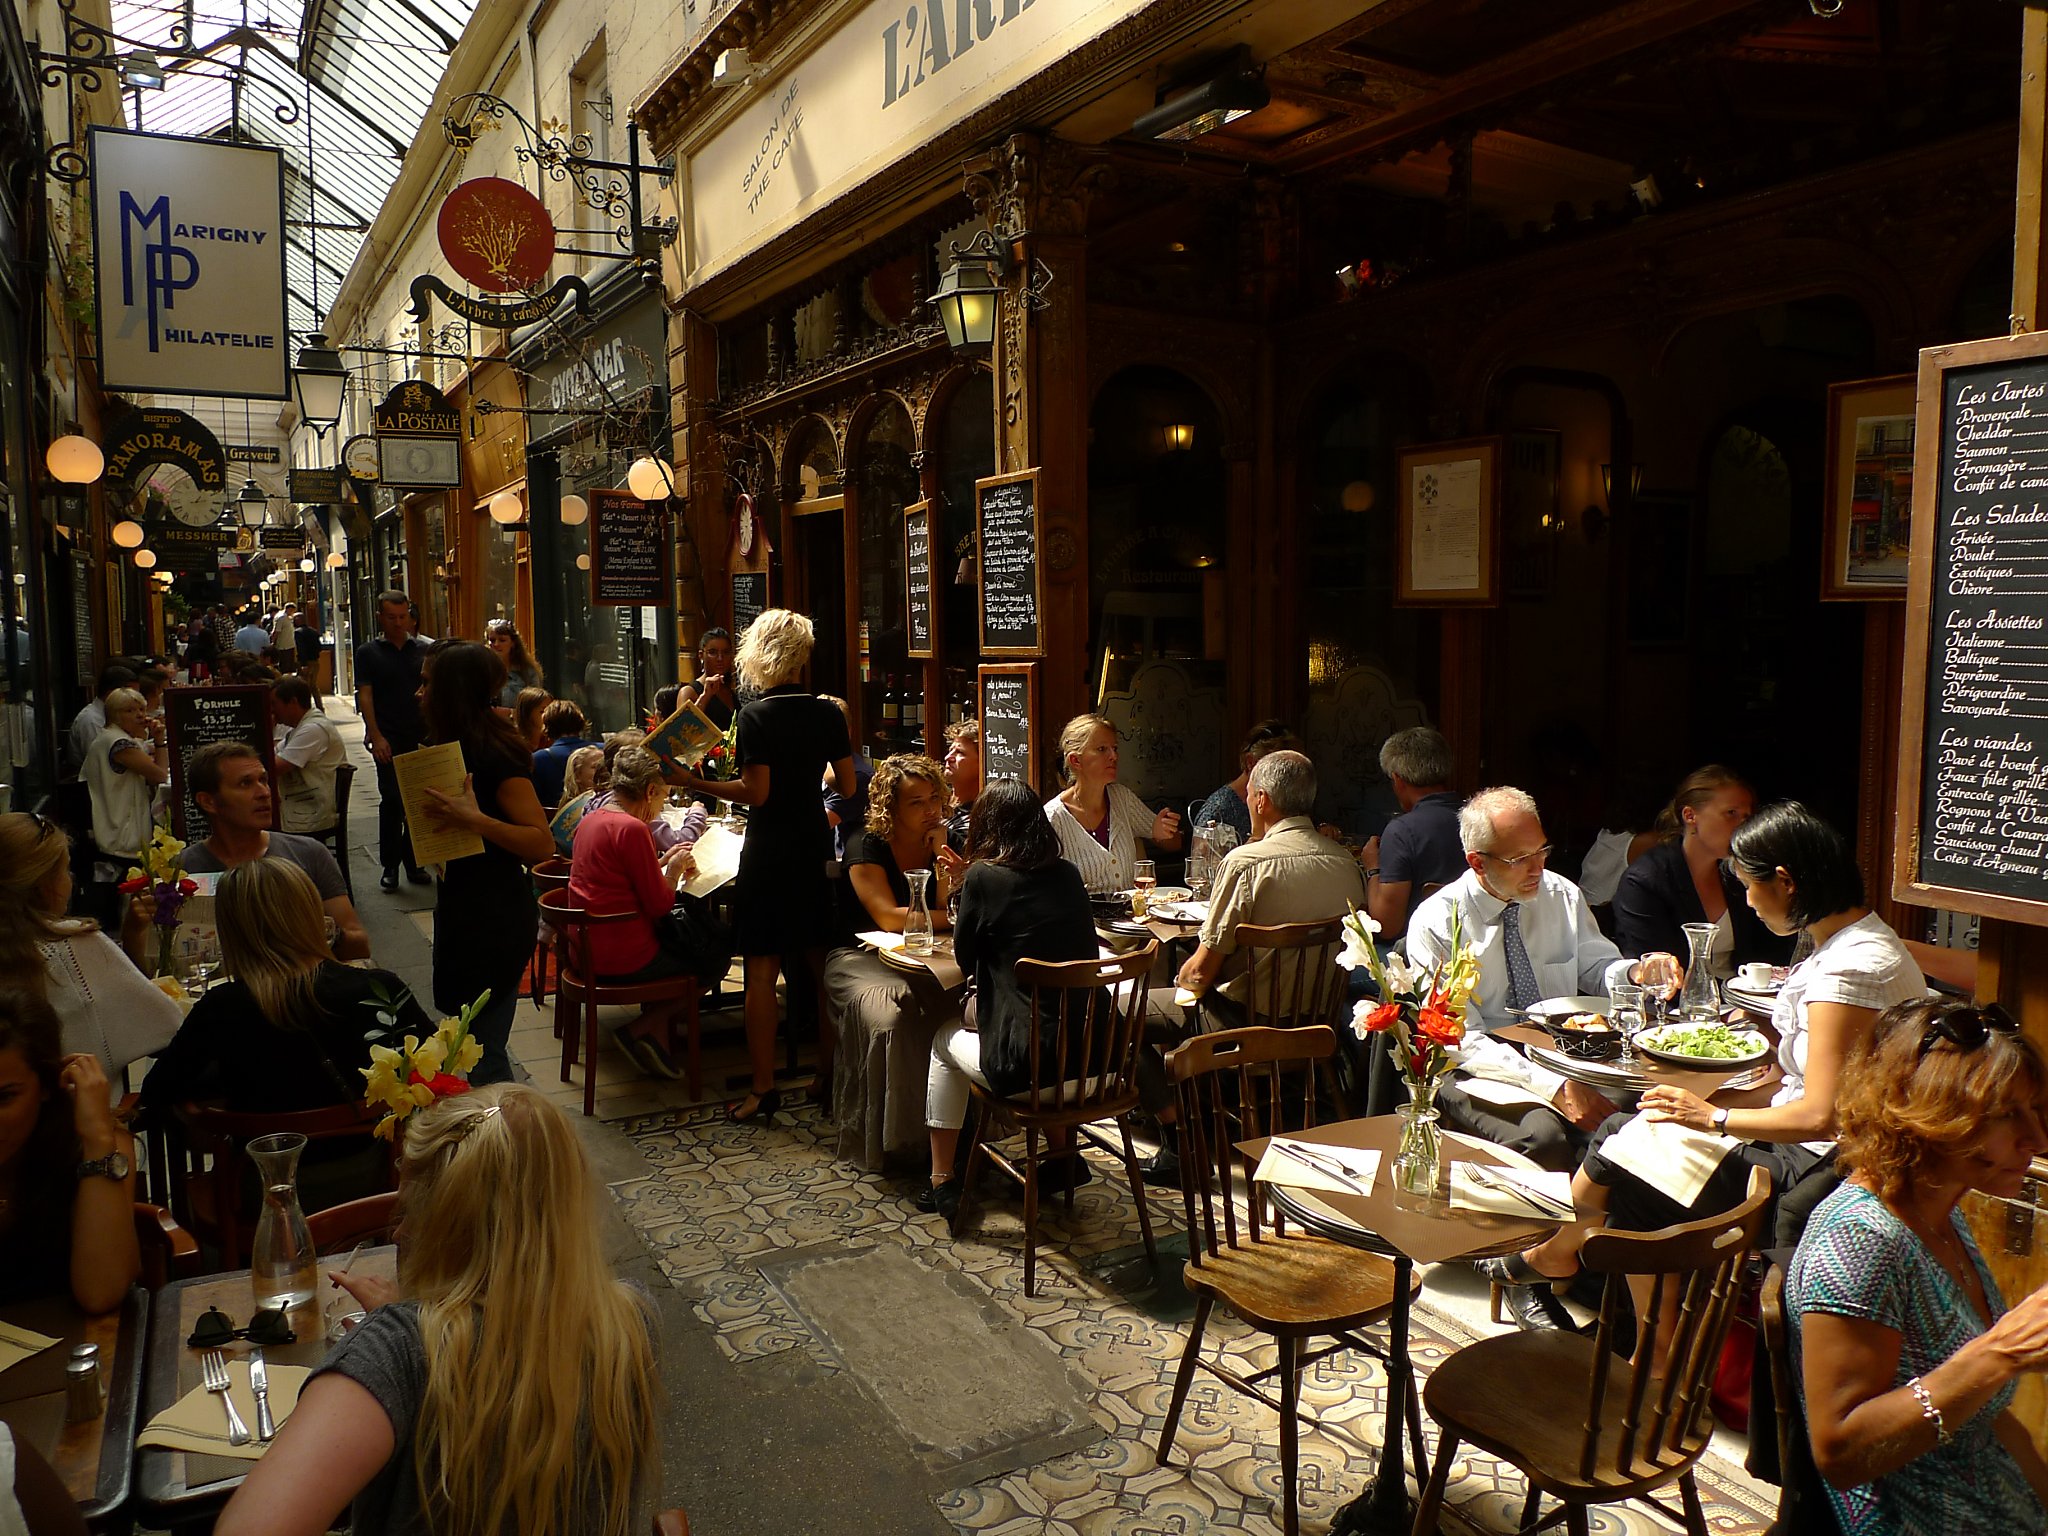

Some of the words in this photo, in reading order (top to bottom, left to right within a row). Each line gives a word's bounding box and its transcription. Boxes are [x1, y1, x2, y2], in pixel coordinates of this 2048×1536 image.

[743, 117, 779, 192] SALON
[781, 78, 799, 117] DE
[748, 170, 771, 214] THE
[772, 106, 804, 170] CAFE
[445, 289, 495, 321] L'Arbre
[499, 308, 508, 322] à
[594, 337, 626, 386] BAR
[1956, 385, 1986, 406] Les
[1991, 380, 2045, 404] Tartes
[143, 414, 182, 423] BISTRO
[375, 411, 396, 429] LA
[398, 412, 460, 431] POSTALE
[1956, 402, 2032, 425] Provençale
[1956, 422, 2013, 443] Cheddar
[107, 432, 221, 485] PANORAMAS
[229, 447, 277, 461] Graveur
[1954, 440, 2008, 459] Saumon
[1953, 458, 2028, 477] Fromagère
[1953, 475, 1996, 495] Confit
[1999, 473, 2016, 490] de
[619, 500, 646, 510] Formu
[1950, 506, 1980, 527] Les
[165, 530, 229, 542] MESSMER
[1950, 529, 1995, 546] Frisée
[1949, 545, 1995, 562] Poulet
[1948, 562, 2013, 582] Exotiques
[1948, 578, 1994, 597] Chèvre
[1945, 608, 1972, 629] Les
[1976, 608, 2044, 630] Assiettes
[1945, 631, 2005, 649] Italienne
[1944, 647, 2000, 668] Baltique
[1941, 681, 2027, 702] Périgourdine
[193, 697, 241, 710] FORMULE
[1941, 697, 2010, 719] Savoyarde
[1938, 727, 1969, 748] Les
[1973, 732, 2033, 752] viandes
[1938, 748, 1977, 767] Pavé
[1979, 752, 1995, 769] de
[1999, 754, 2039, 775] boeuf
[1937, 766, 1978, 784] Faux
[1981, 769, 2009, 788] filet
[1936, 782, 1995, 802] Entrecote
[1936, 797, 1991, 818] Rognons
[1995, 805, 2012, 821] de
[1935, 814, 1976, 835] Confit
[1979, 820, 1997, 836] de
[1933, 830, 1997, 852] Saucisson
[2000, 838, 2042, 859] chaud
[1933, 846, 1969, 866] Cotes
[1972, 852, 2039, 875] d'Agneau
